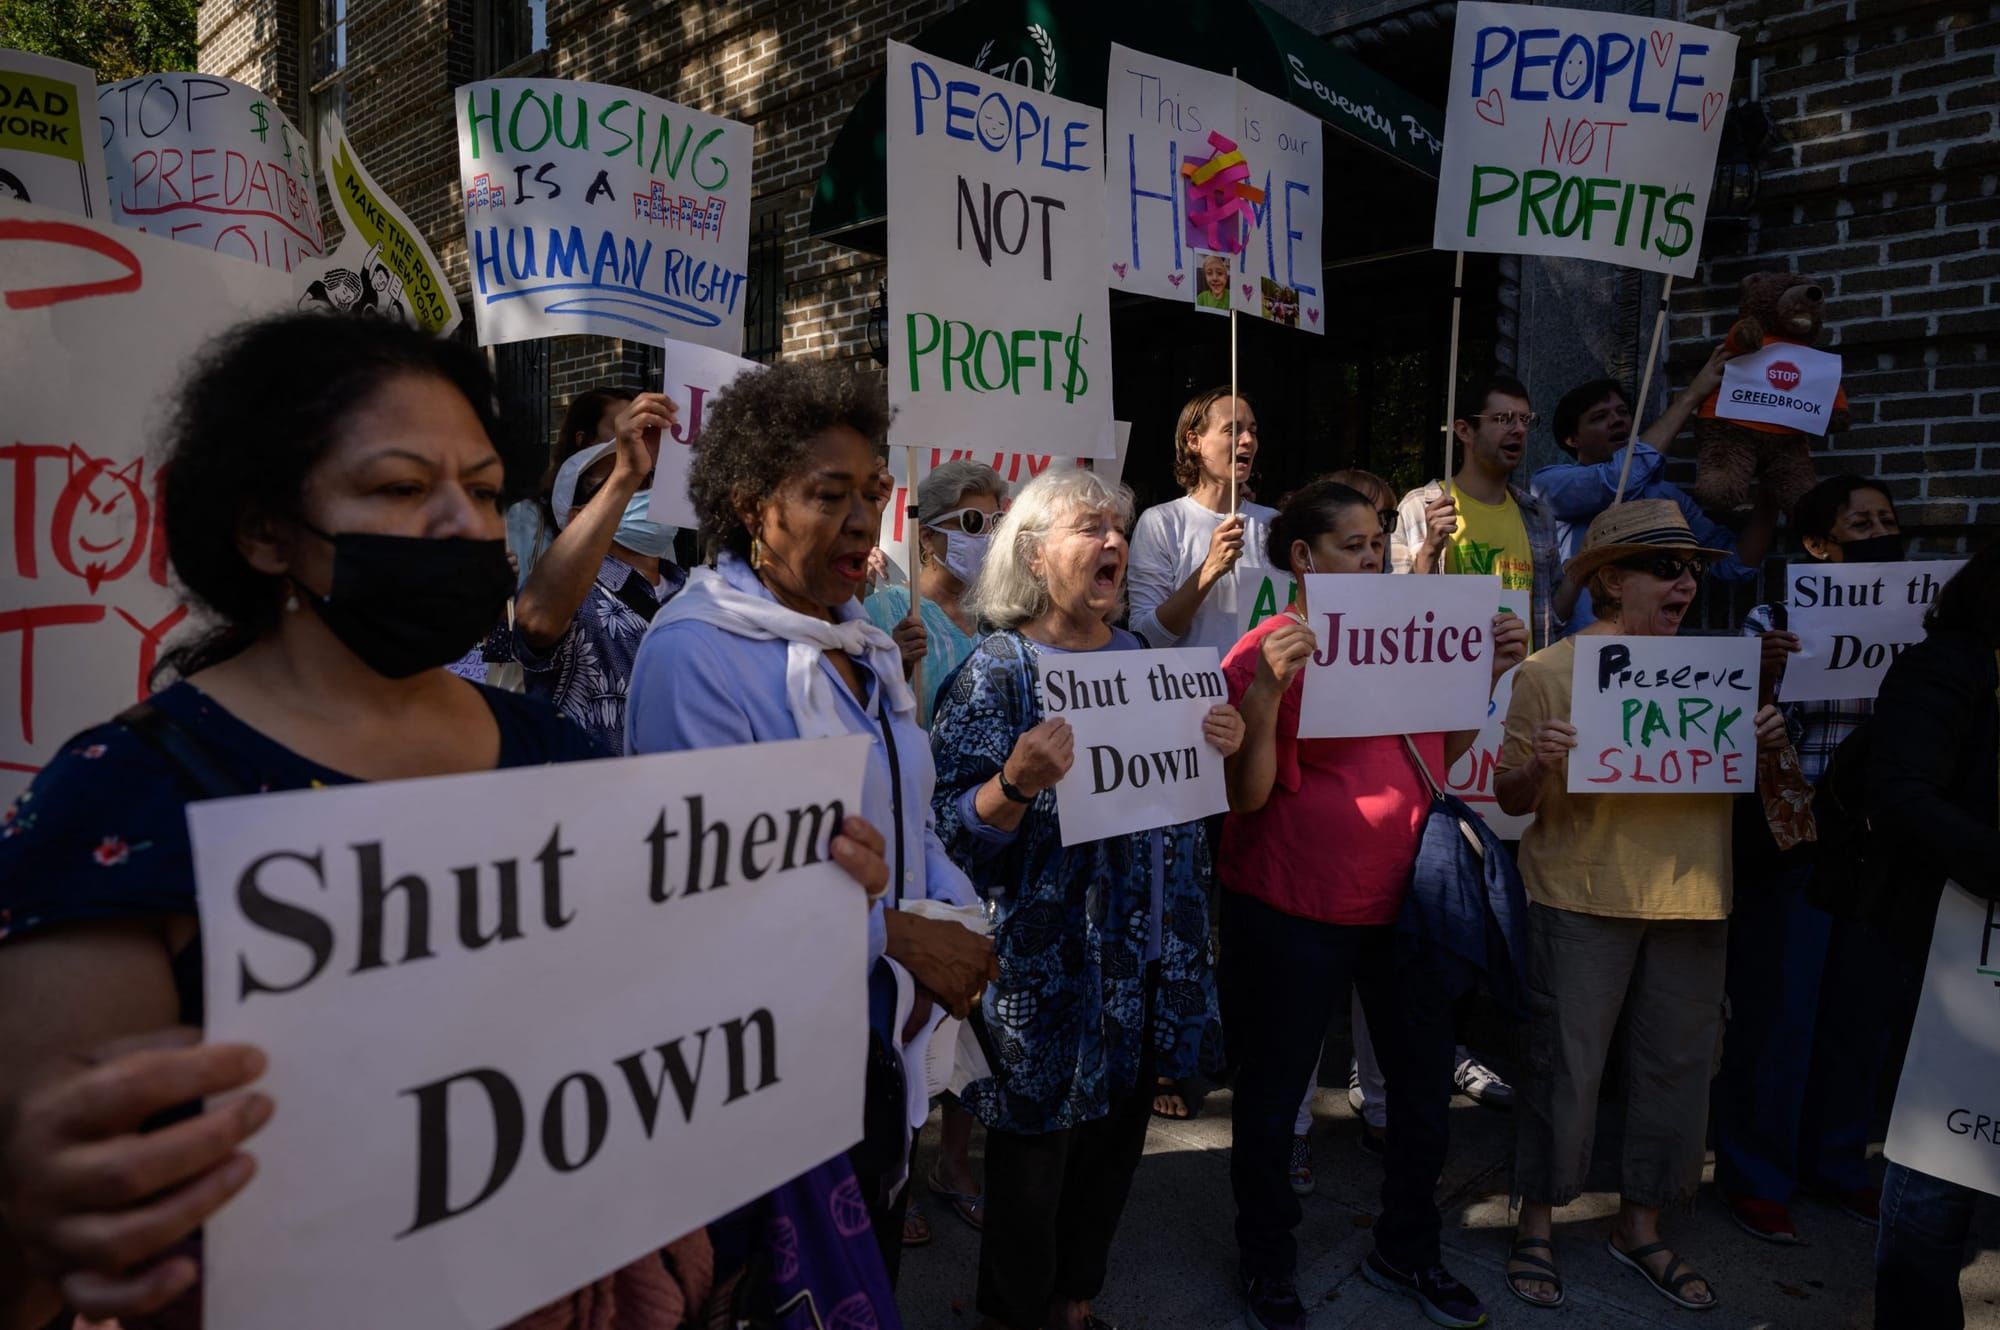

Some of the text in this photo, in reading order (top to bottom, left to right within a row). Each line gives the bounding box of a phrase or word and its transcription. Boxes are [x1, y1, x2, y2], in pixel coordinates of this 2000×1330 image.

[1287, 52, 1397, 149] Seventy
[1471, 26, 1710, 123] PEOPLE
[98, 78, 230, 149] STOP
[467, 88, 729, 192] HOUSING
[910, 61, 1092, 172] PEOPLE
[1126, 69, 1309, 156] This is our
[1540, 116, 1629, 172] NOT
[513, 162, 616, 205] IS A
[1129, 134, 1317, 297] HME
[345, 173, 444, 322] MAKE THE ROAD
[957, 175, 1066, 281] NOT
[390, 250, 433, 328] NEW YOR
[475, 225, 750, 315] HUMAN RIGHT
[1732, 389, 1822, 416] GREEDBROOK
[1768, 369, 1799, 383] STOP
[1794, 573, 1941, 608] Shut th
[1313, 611, 1482, 667] Justice
[1599, 643, 1753, 694] Preserve
[1045, 664, 1224, 713] Shut them
[1622, 697, 1743, 755] PARK
[1085, 744, 1201, 795] Down
[1587, 747, 1743, 785] SLOPE
[235, 794, 848, 1004] Shut them
[393, 1005, 783, 1243] Down
